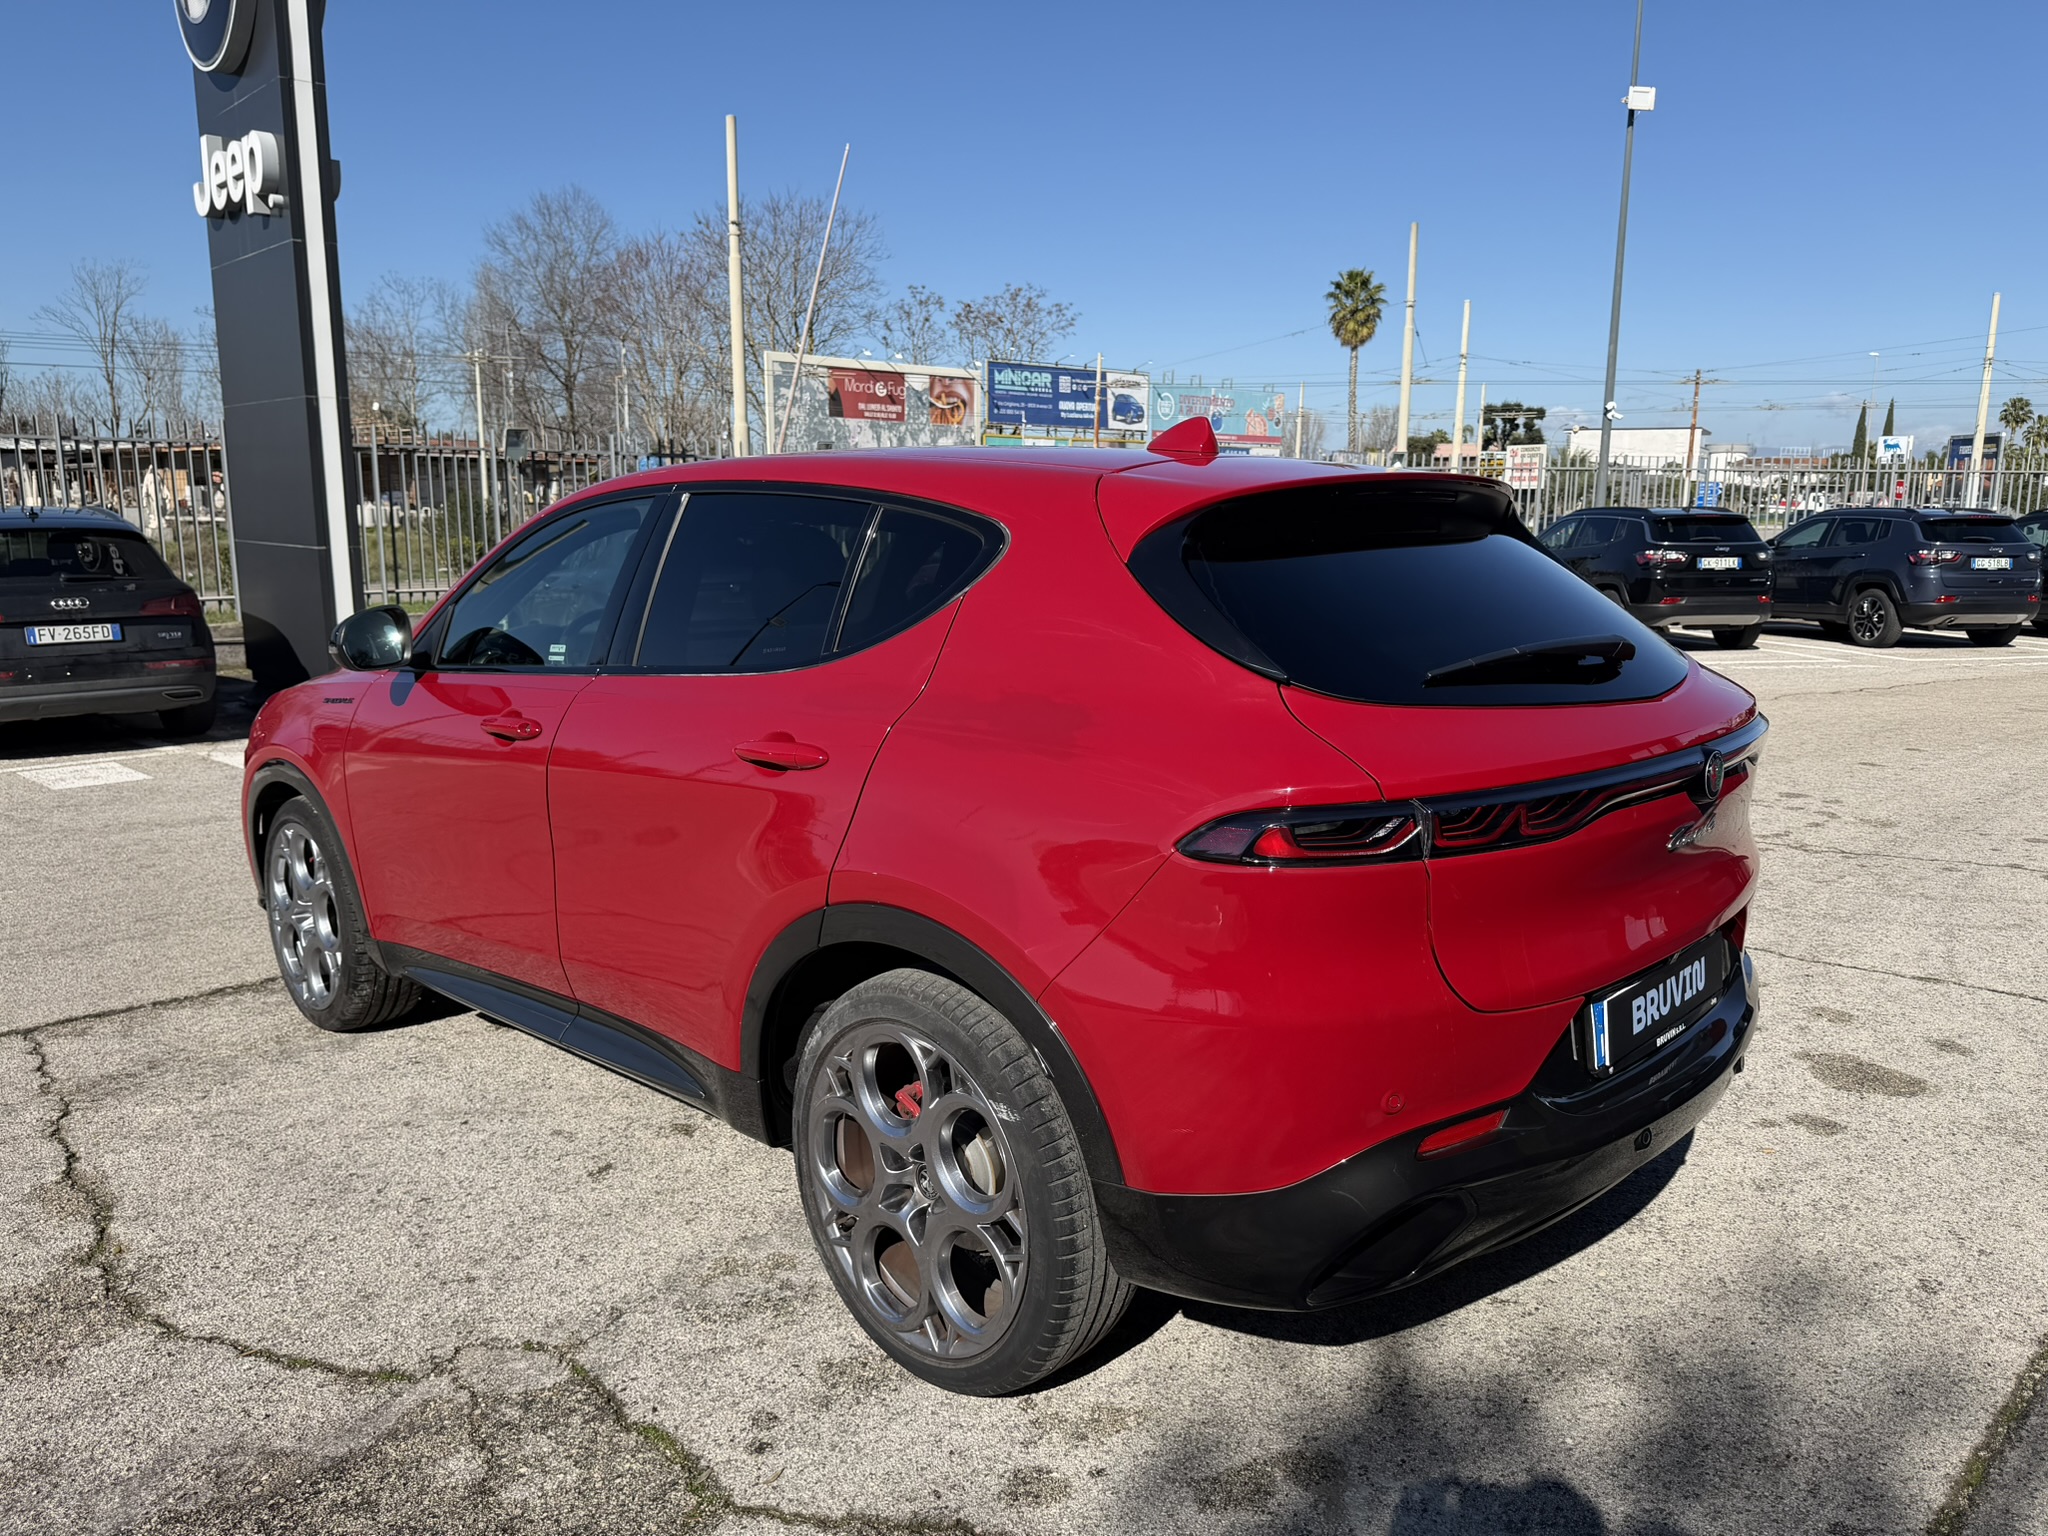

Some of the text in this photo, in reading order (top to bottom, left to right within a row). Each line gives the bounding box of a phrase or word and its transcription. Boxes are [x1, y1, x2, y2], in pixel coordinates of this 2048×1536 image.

[193, 130, 279, 217] Jeep
[844, 378, 874, 394] Mordi
[1632, 956, 1706, 1036] BRUVIN
